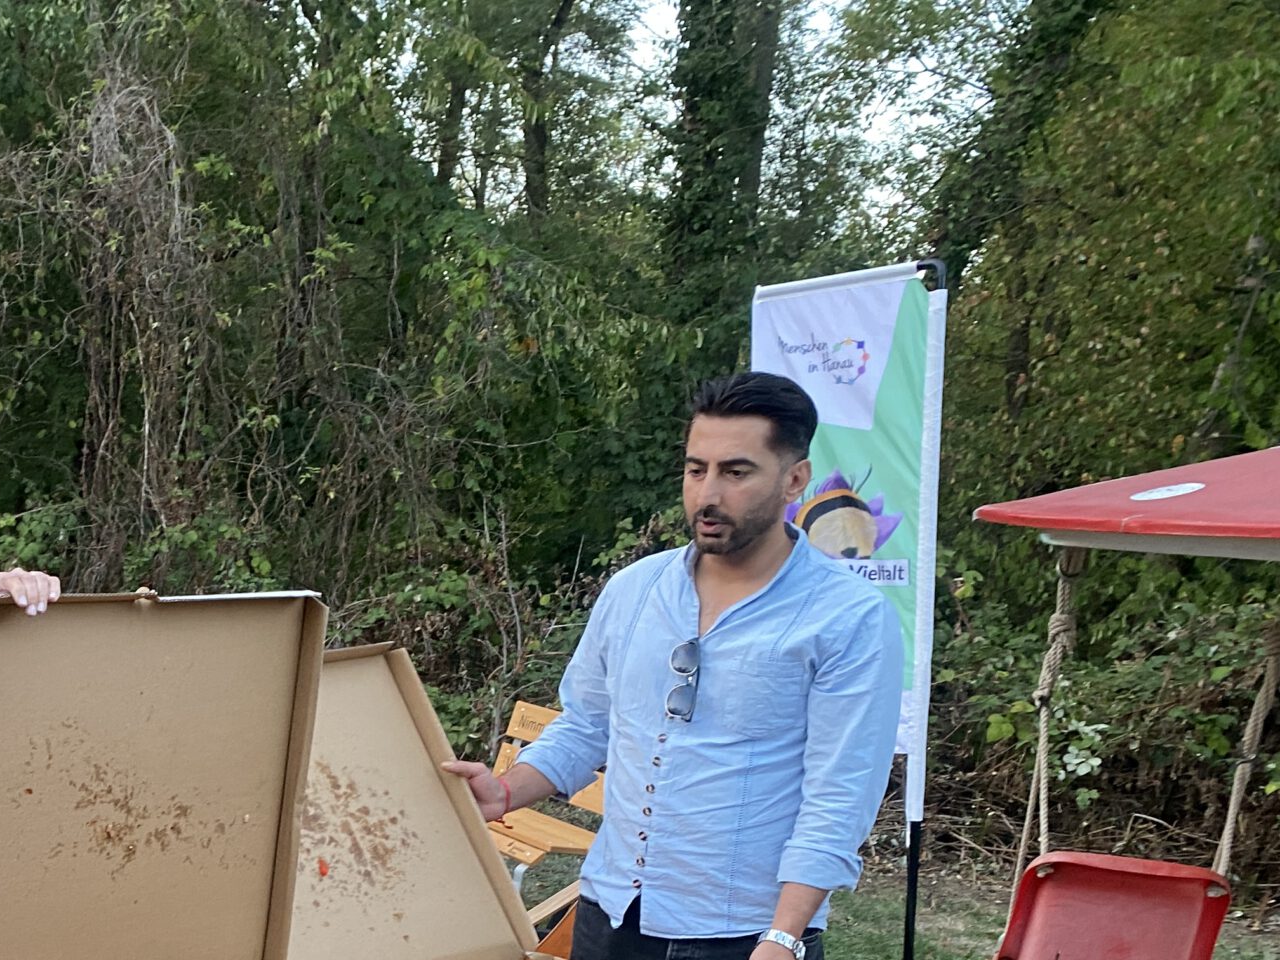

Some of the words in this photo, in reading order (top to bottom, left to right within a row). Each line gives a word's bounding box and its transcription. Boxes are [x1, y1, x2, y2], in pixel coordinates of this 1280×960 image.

[778, 333, 828, 354] Menschen
[807, 361, 819, 373] in
[821, 351, 854, 372] Hanau
